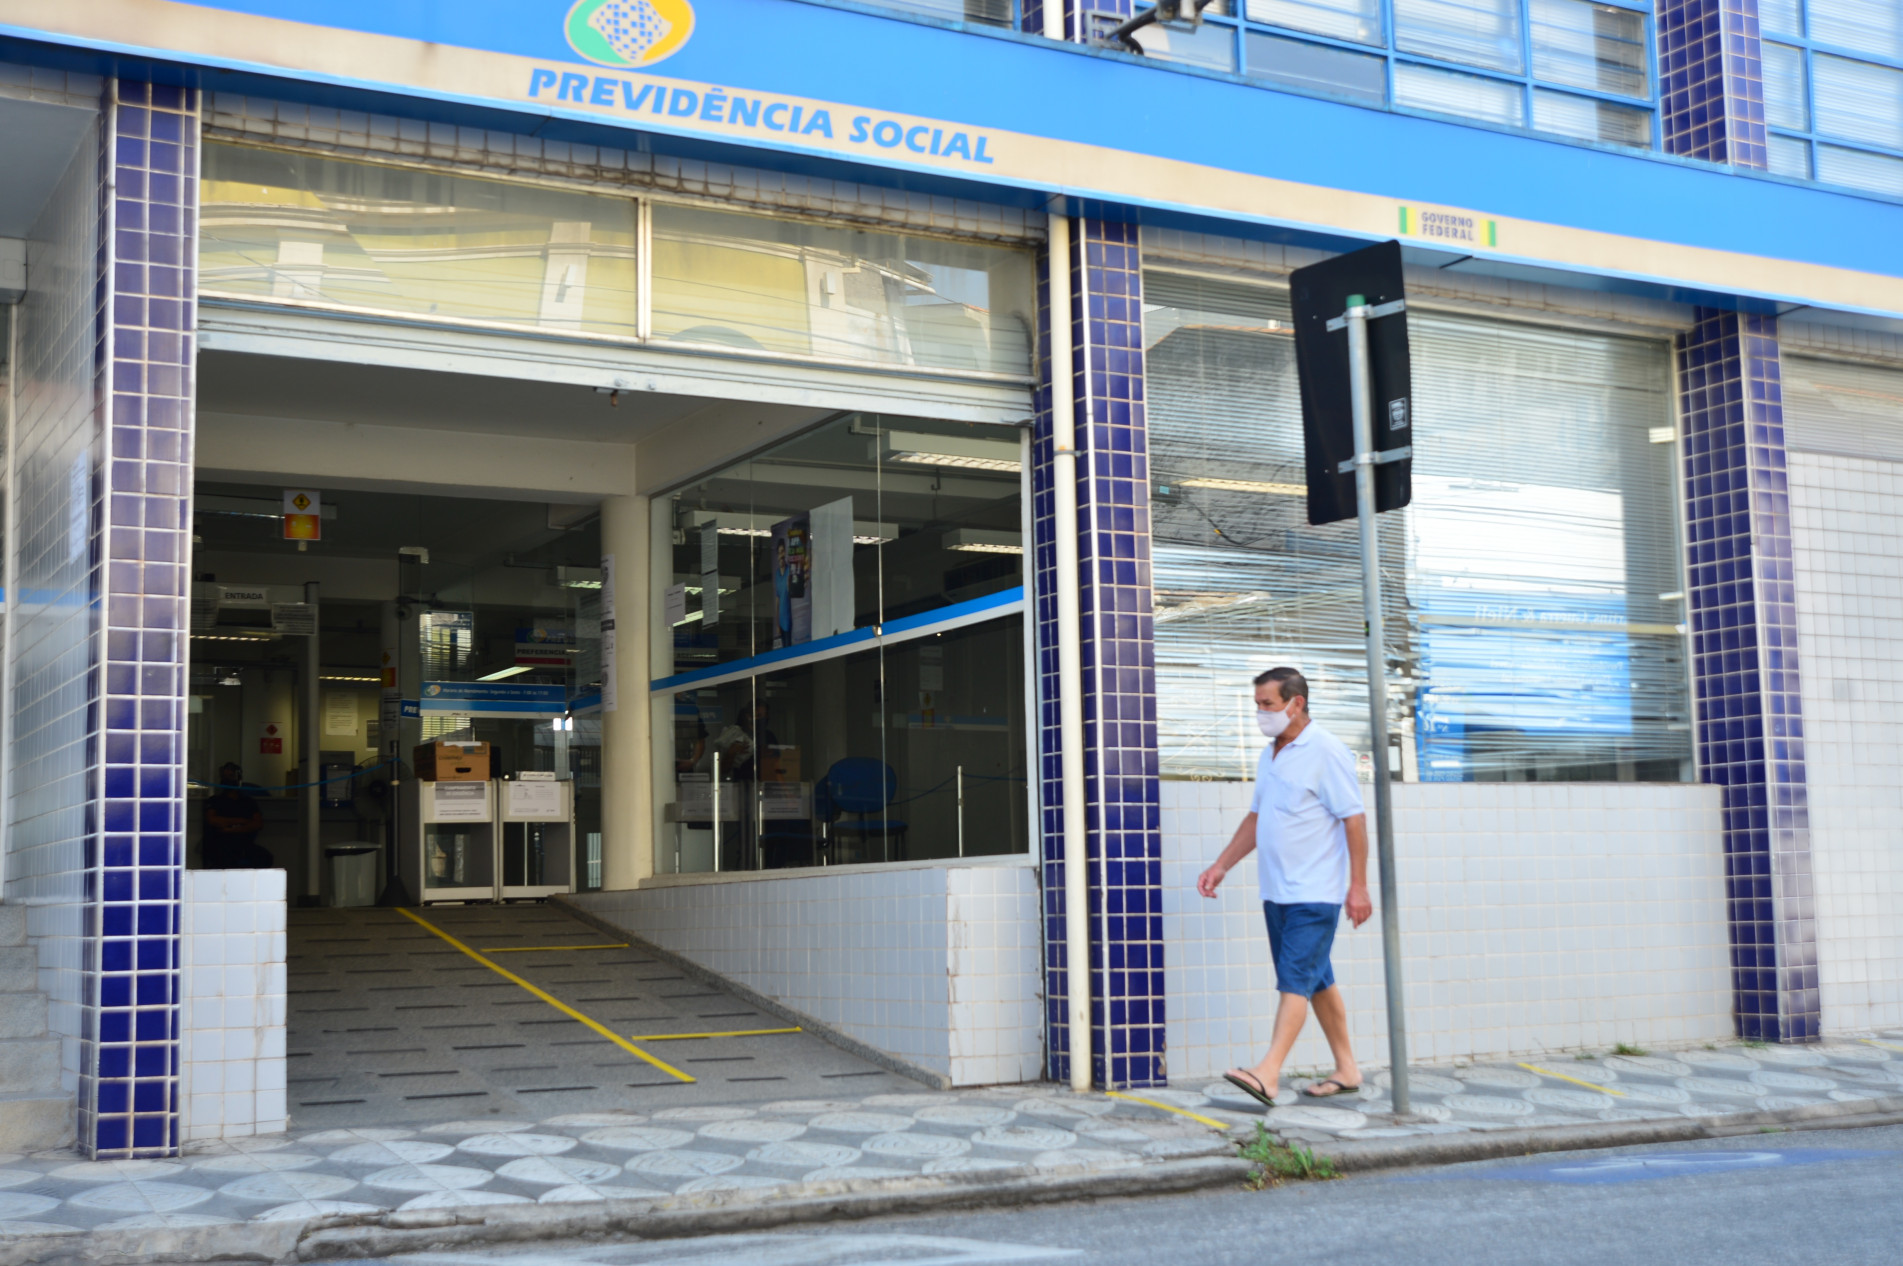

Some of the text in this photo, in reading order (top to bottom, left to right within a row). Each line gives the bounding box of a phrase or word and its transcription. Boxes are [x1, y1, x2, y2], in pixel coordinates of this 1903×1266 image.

[528, 68, 994, 164] PREVIDÊNCIA SOCIAL
[1422, 211, 1473, 228] GOVERNO
[1422, 223, 1473, 241] FEDERAL
[225, 592, 263, 600] ENTRADA
[517, 648, 569, 656] PREFERENCIA
